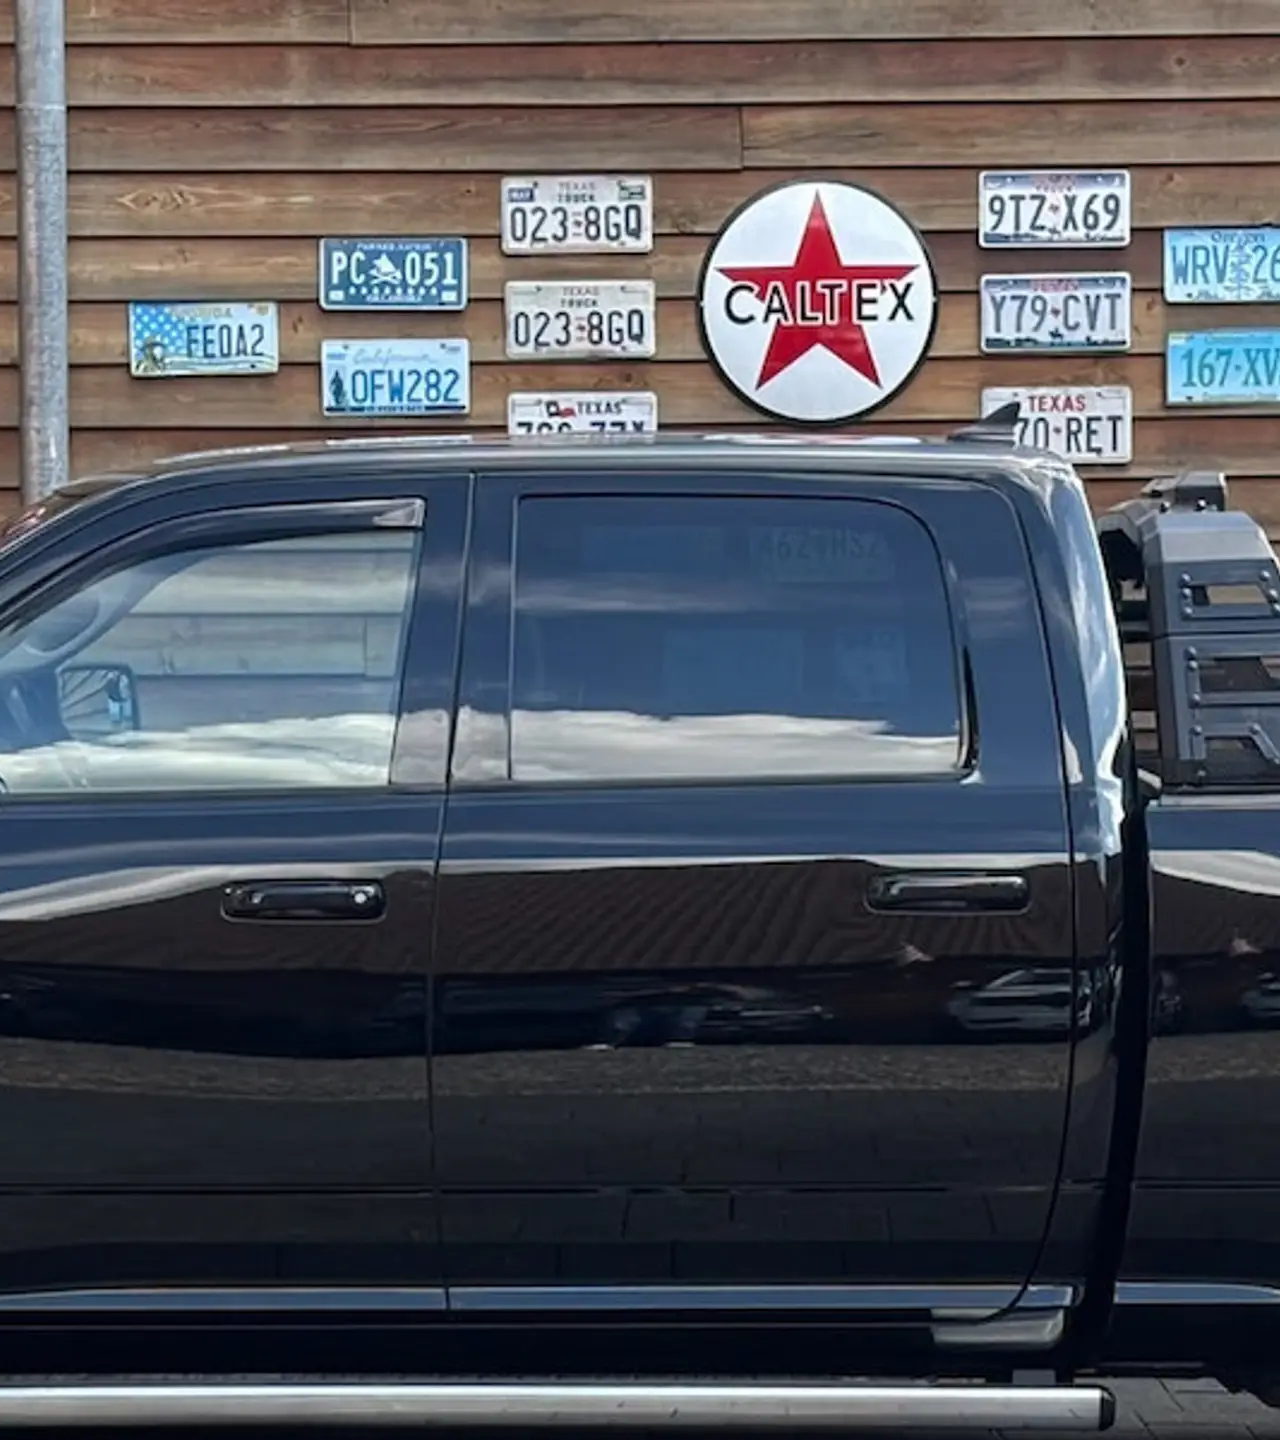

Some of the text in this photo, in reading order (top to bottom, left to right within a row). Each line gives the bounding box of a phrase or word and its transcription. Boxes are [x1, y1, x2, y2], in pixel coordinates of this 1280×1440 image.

[331, 251, 459, 286] PC 051
[723, 281, 915, 326] CALTEX
[577, 401, 623, 416] TEXAS
[1027, 395, 1086, 412] TEXAS
